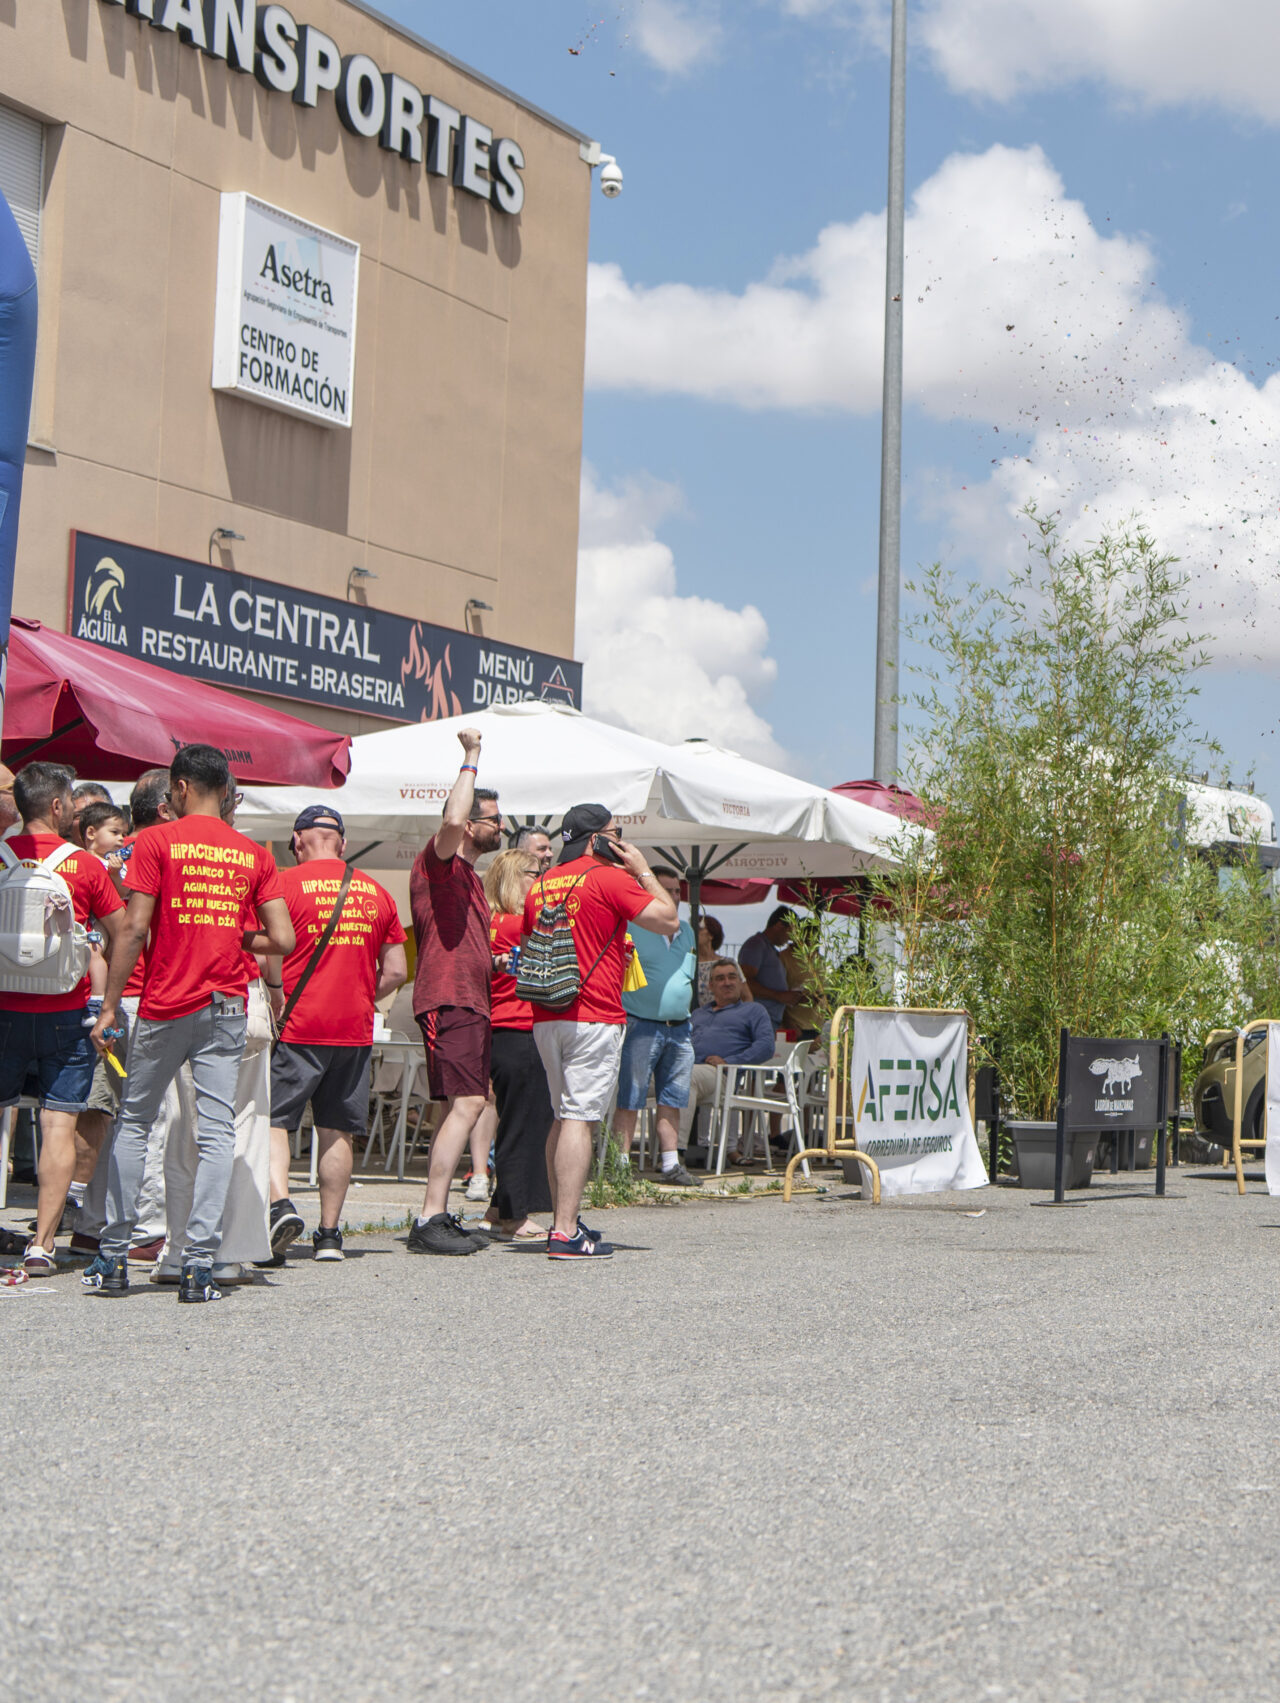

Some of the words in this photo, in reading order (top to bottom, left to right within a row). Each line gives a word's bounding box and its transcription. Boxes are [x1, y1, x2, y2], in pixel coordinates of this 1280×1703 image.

[116, 0, 525, 215] ANSPORTES
[259, 244, 334, 306] Asetra
[241, 324, 296, 363] CENTRO
[301, 347, 319, 373] DE
[240, 352, 346, 414] FORMACIÓN
[103, 609, 112, 622] EL
[173, 574, 221, 626] LA
[229, 589, 381, 664] CENTRAL
[77, 613, 128, 647] ÁGUILA
[141, 626, 299, 686] RESTAURANTE
[310, 664, 405, 708] BRASERIA
[478, 649, 534, 686] MENÚ
[399, 788, 452, 799] VICTO
[722, 802, 751, 817] VICTORIA
[182, 865, 224, 878] ABANICO
[228, 869, 236, 880] Y
[183, 882, 207, 892] AGUA
[171, 897, 183, 908] EL
[187, 898, 204, 908] PAN
[356, 895, 363, 904] Y
[178, 914, 191, 924] DE
[194, 914, 215, 926] CADA
[218, 914, 236, 927] DÍA
[307, 924, 318, 933] EL
[328, 936, 350, 946] CADA
[352, 934, 365, 946] DÍA
[856, 1057, 961, 1123] AFERSA
[910, 1137, 921, 1155] DE
[921, 1135, 953, 1154] SEGUROS
